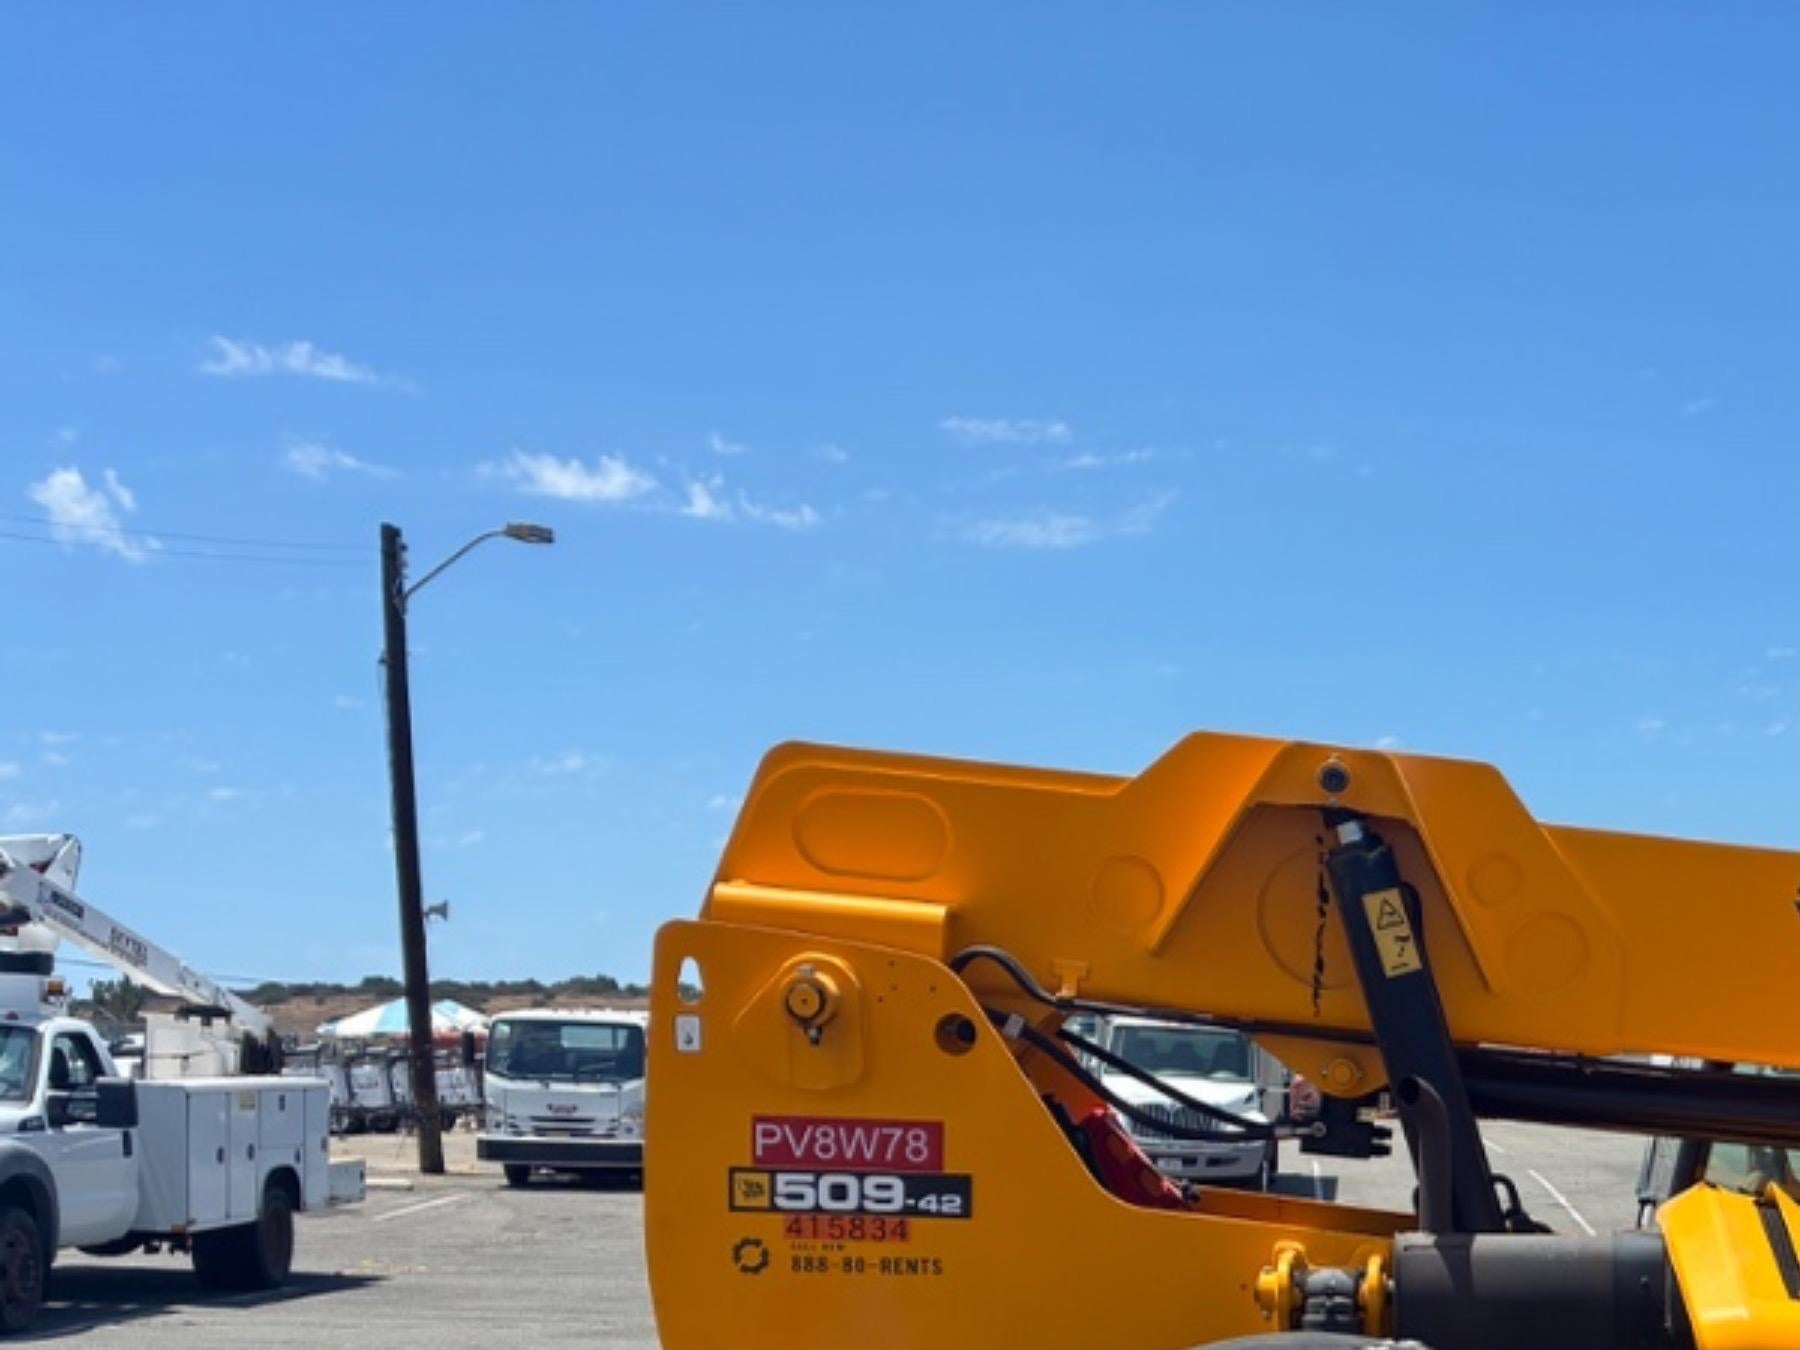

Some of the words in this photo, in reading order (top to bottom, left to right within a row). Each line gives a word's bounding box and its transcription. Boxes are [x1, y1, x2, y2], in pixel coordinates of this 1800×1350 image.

[755, 1123, 929, 1163] PV8W78
[774, 1172, 962, 1214] 509-42
[785, 1215, 908, 1242] 415834
